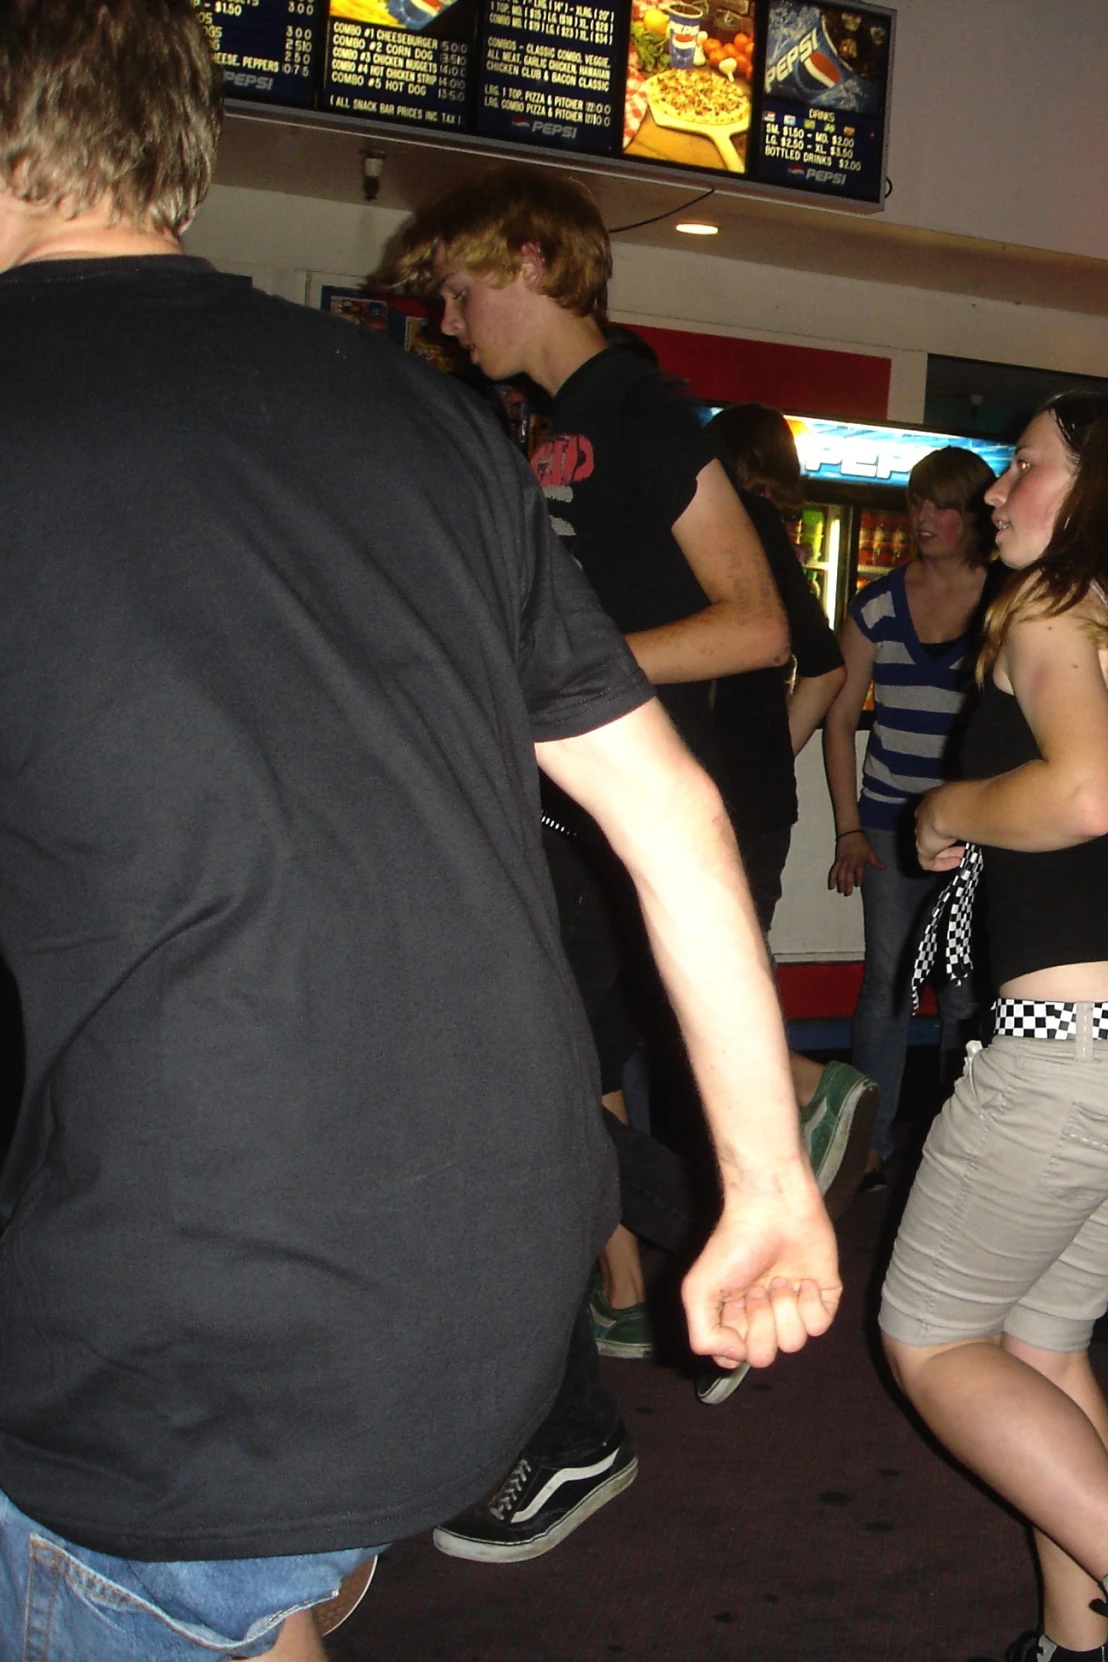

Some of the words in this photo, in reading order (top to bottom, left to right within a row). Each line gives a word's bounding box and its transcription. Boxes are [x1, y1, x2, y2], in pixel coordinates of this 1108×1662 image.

[489, 12, 511, 26] COMBO
[333, 21, 362, 37] COMBO
[364, 28, 374, 39] #1
[376, 29, 438, 50] CHEESEBURGER
[333, 34, 365, 50] COMBO
[369, 41, 382, 53] #2
[386, 43, 411, 57] CORN
[414, 47, 433, 61] DOG
[487, 36, 517, 51] COMBOS
[526, 43, 556, 58] CLASSIC
[242, 56, 279, 73] PEPPERS
[332, 46, 358, 61] COMBO
[360, 51, 371, 63] #3
[373, 52, 404, 68] CHICKEN
[405, 58, 437, 74] NUGGETS
[487, 48, 500, 60] ALL
[523, 55, 547, 69] GARLIC
[765, 27, 819, 93] PEPSI
[223, 70, 274, 90] PEPSI
[331, 58, 356, 73] COMBO
[358, 63, 368, 75] #4
[370, 65, 385, 77] HOT
[386, 67, 415, 83] CHICKEN
[417, 72, 437, 86] STRIP
[486, 60, 519, 76] CHICKEN
[521, 66, 542, 80] CLUB
[551, 71, 576, 87] BACON
[578, 76, 610, 92] CLASSIC
[331, 70, 364, 87] COMBO
[368, 77, 381, 89] #5
[385, 79, 404, 93] HOT
[408, 84, 427, 97] DOG
[353, 98, 377, 112] SNACK
[380, 102, 395, 116] BAR
[397, 104, 423, 120] PRICES
[501, 98, 524, 113] COMBO
[526, 103, 546, 117] PIZZA
[554, 107, 583, 123] PITCHER
[525, 91, 545, 105] PIZZA
[554, 95, 583, 111] PITCHER
[808, 108, 836, 122] DRINKS
[531, 120, 578, 139] PEPSI
[782, 125, 805, 139] $1.50
[831, 134, 855, 148] $2.00
[764, 145, 801, 161] BOTTLED
[803, 151, 832, 167] DRINKS
[838, 158, 862, 172] $2.00
[780, 137, 804, 150] $2.50
[830, 145, 854, 159] $3.50
[805, 168, 847, 185] PEPSI
[803, 438, 912, 480] PEP
